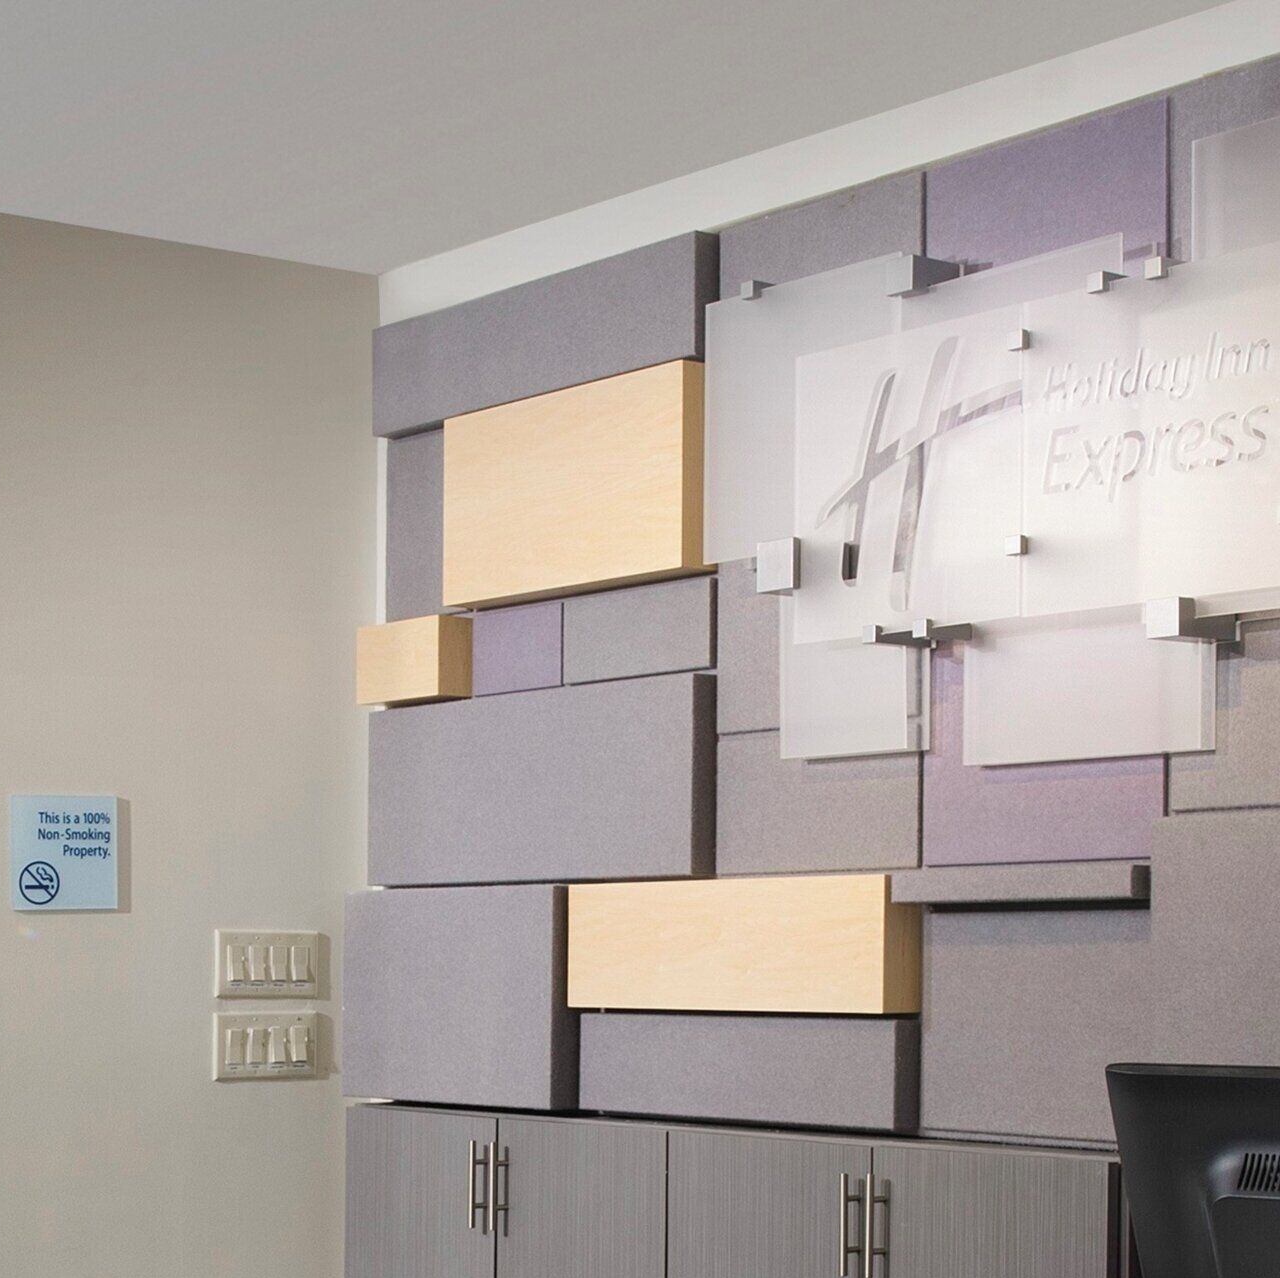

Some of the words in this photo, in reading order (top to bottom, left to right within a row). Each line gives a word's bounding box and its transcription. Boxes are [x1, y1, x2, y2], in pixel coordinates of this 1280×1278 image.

[1043, 348, 1195, 405] Holiday
[1206, 332, 1270, 380] Inn
[1043, 405, 1269, 502] Express
[38, 811, 60, 824] This
[62, 811, 71, 824] is
[73, 814, 80, 824] a
[83, 812, 111, 825] 100%
[37, 828, 111, 843] Non-Smoking
[63, 844, 111, 859] Property.
